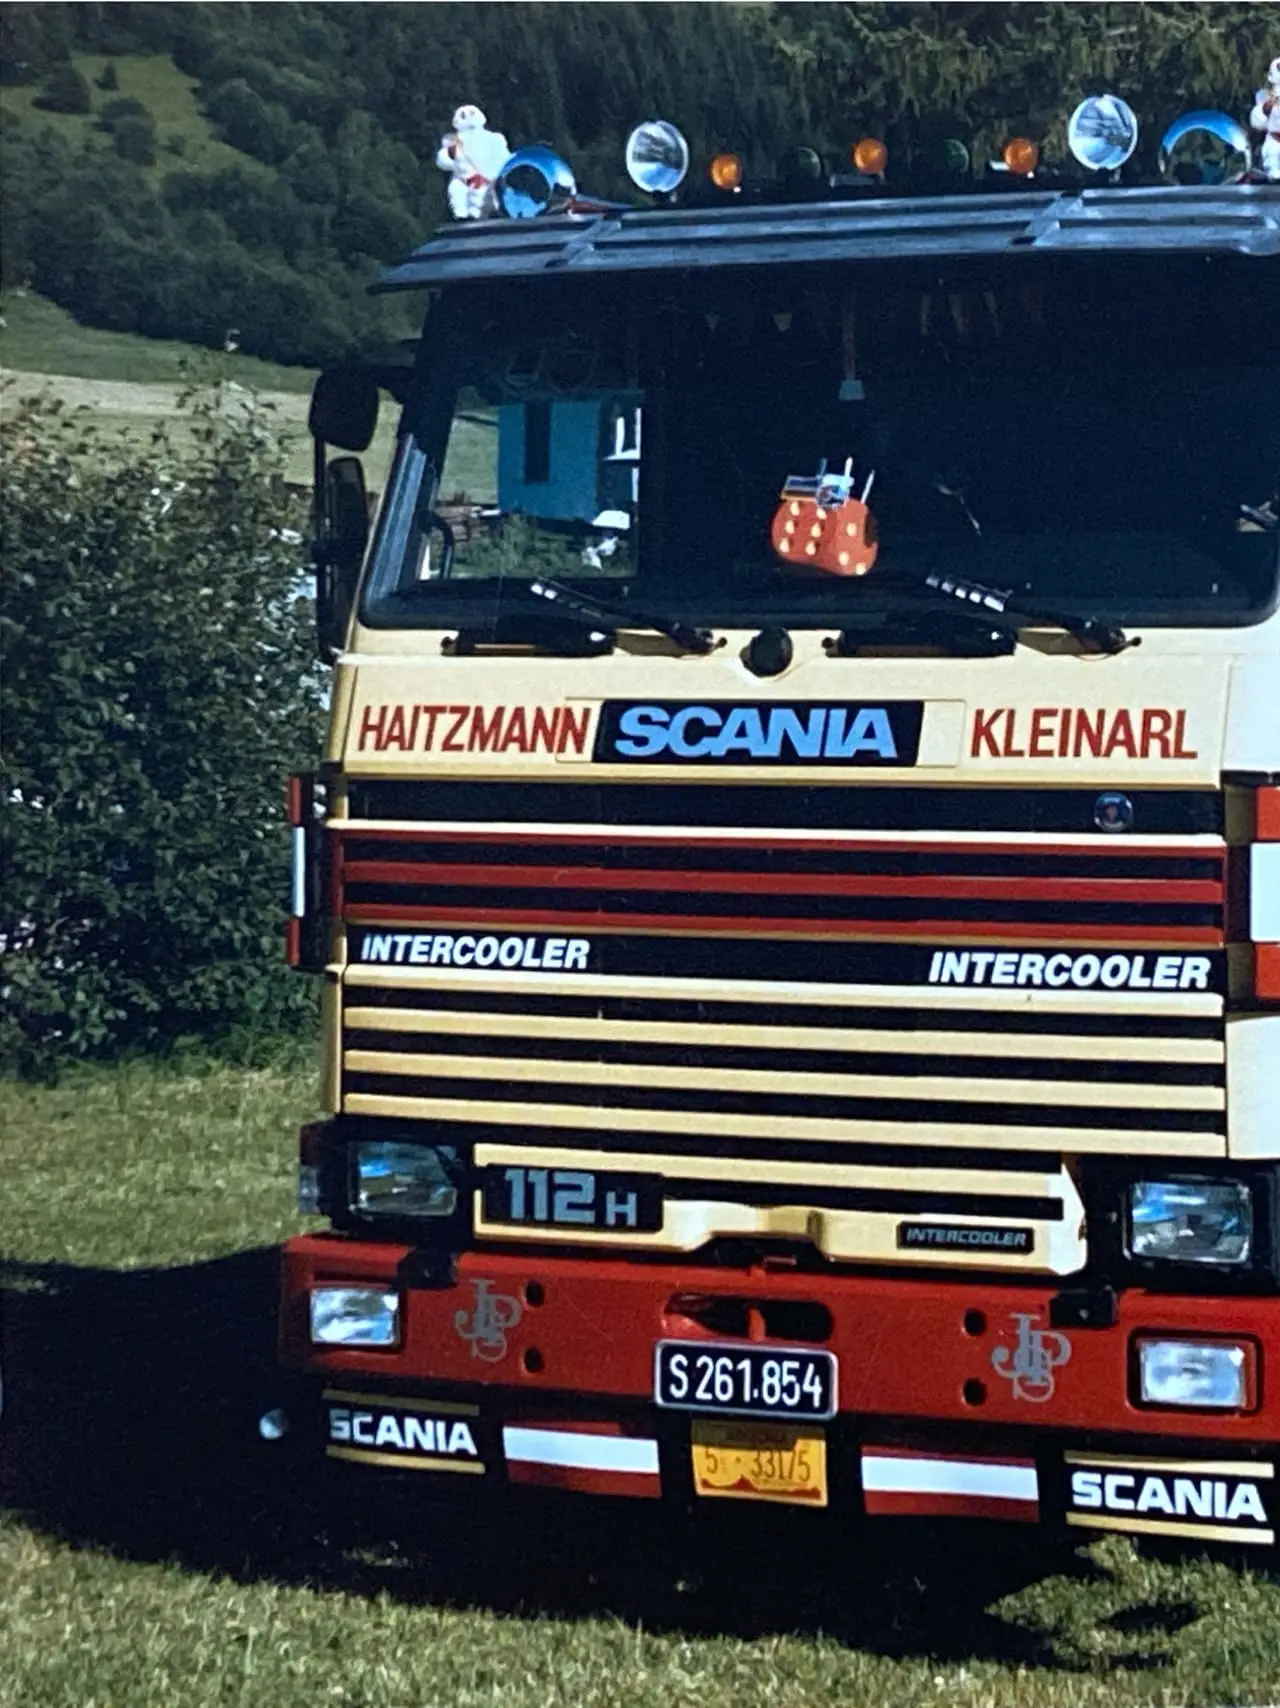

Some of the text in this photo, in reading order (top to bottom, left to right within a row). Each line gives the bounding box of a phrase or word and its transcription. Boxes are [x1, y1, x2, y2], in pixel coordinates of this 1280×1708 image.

[359, 703, 590, 754] HAITZMANN
[614, 705, 898, 759] SCANIA
[970, 707, 1198, 759] KLEINARL
[361, 932, 591, 970] INTERCOOLER
[928, 951, 1212, 990] INTERCOOLER
[504, 1167, 638, 1227] 112 H
[905, 1226, 1028, 1250] INTERCOOLER
[669, 1353, 823, 1409] S 261.854
[329, 1408, 478, 1456] SCANIA
[1070, 1471, 1269, 1523] SCANIA
